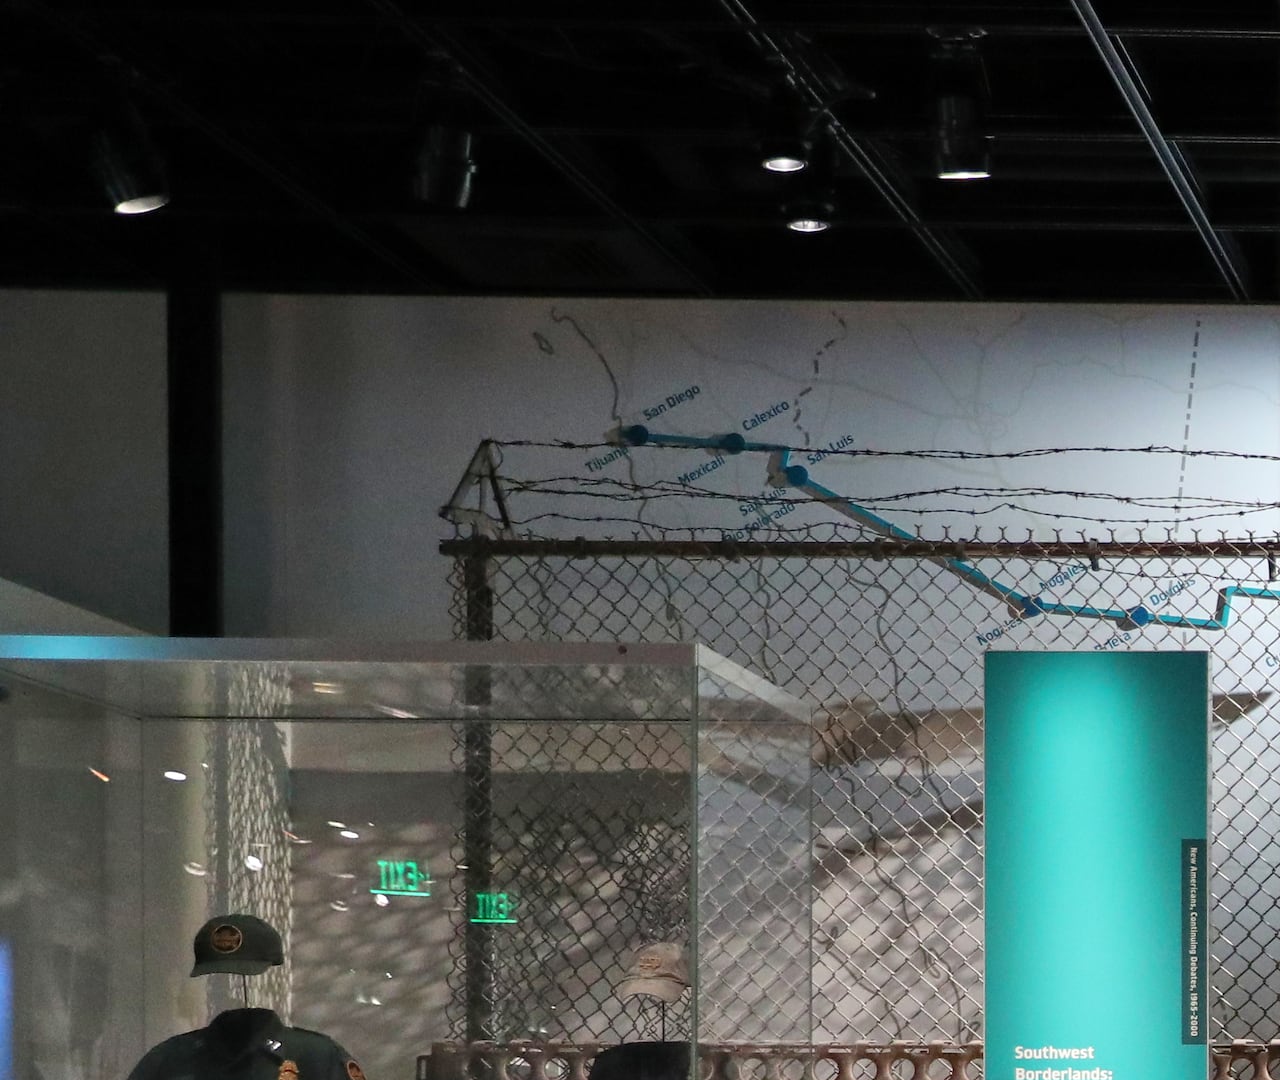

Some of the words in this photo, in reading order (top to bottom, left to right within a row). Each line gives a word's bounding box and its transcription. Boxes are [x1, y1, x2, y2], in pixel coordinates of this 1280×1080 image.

[642, 402, 667, 421] San
[666, 384, 700, 408] Diego
[742, 400, 790, 431] Calexico
[677, 454, 726, 485] Mexicali
[1190, 847, 1198, 864] New
[1189, 866, 1198, 911] Americans,
[1189, 913, 1198, 955] Continuing
[1189, 957, 1198, 991] Debates,
[1014, 1045, 1095, 1060] Southwest
[1015, 1067, 1113, 1080] Borderlands:
